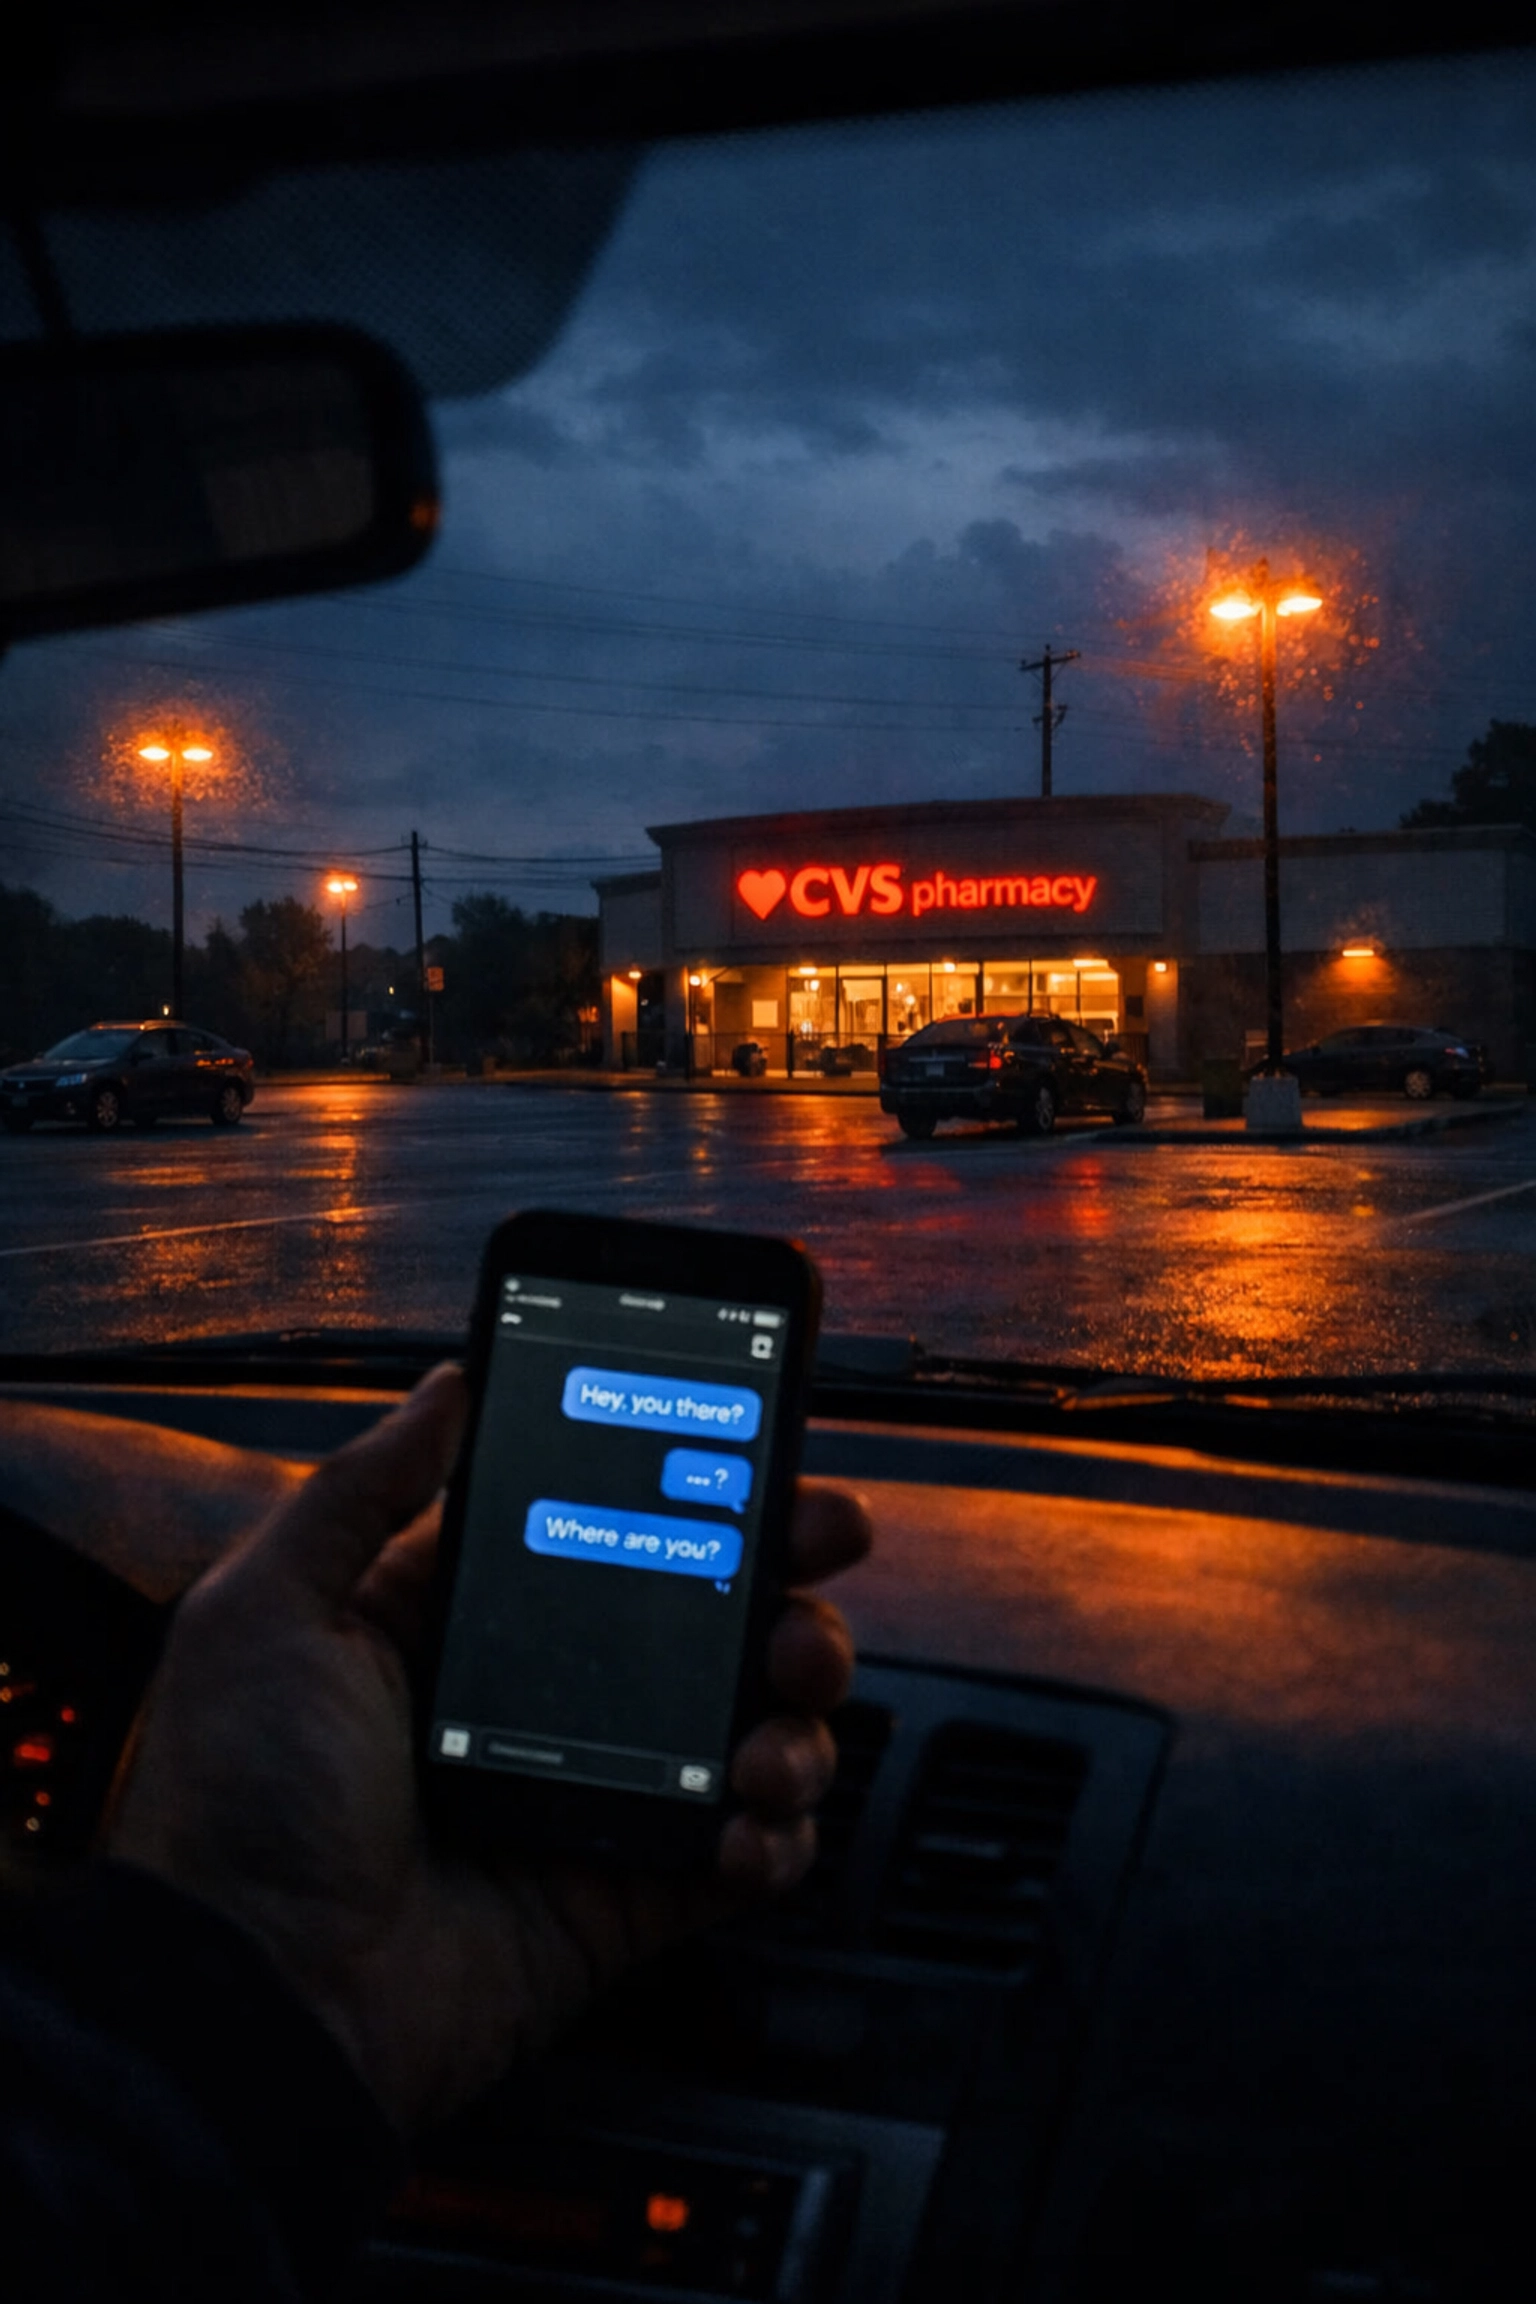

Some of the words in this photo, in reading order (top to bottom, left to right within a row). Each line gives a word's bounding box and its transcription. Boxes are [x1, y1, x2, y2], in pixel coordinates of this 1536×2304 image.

[789, 864, 903, 918] CVS
[912, 871, 1098, 917] pharmacy
[631, 1394, 672, 1415] you
[676, 1397, 745, 1425] there?
[545, 1516, 619, 1547] Where
[623, 1532, 661, 1554] are
[665, 1538, 721, 1561] you?
